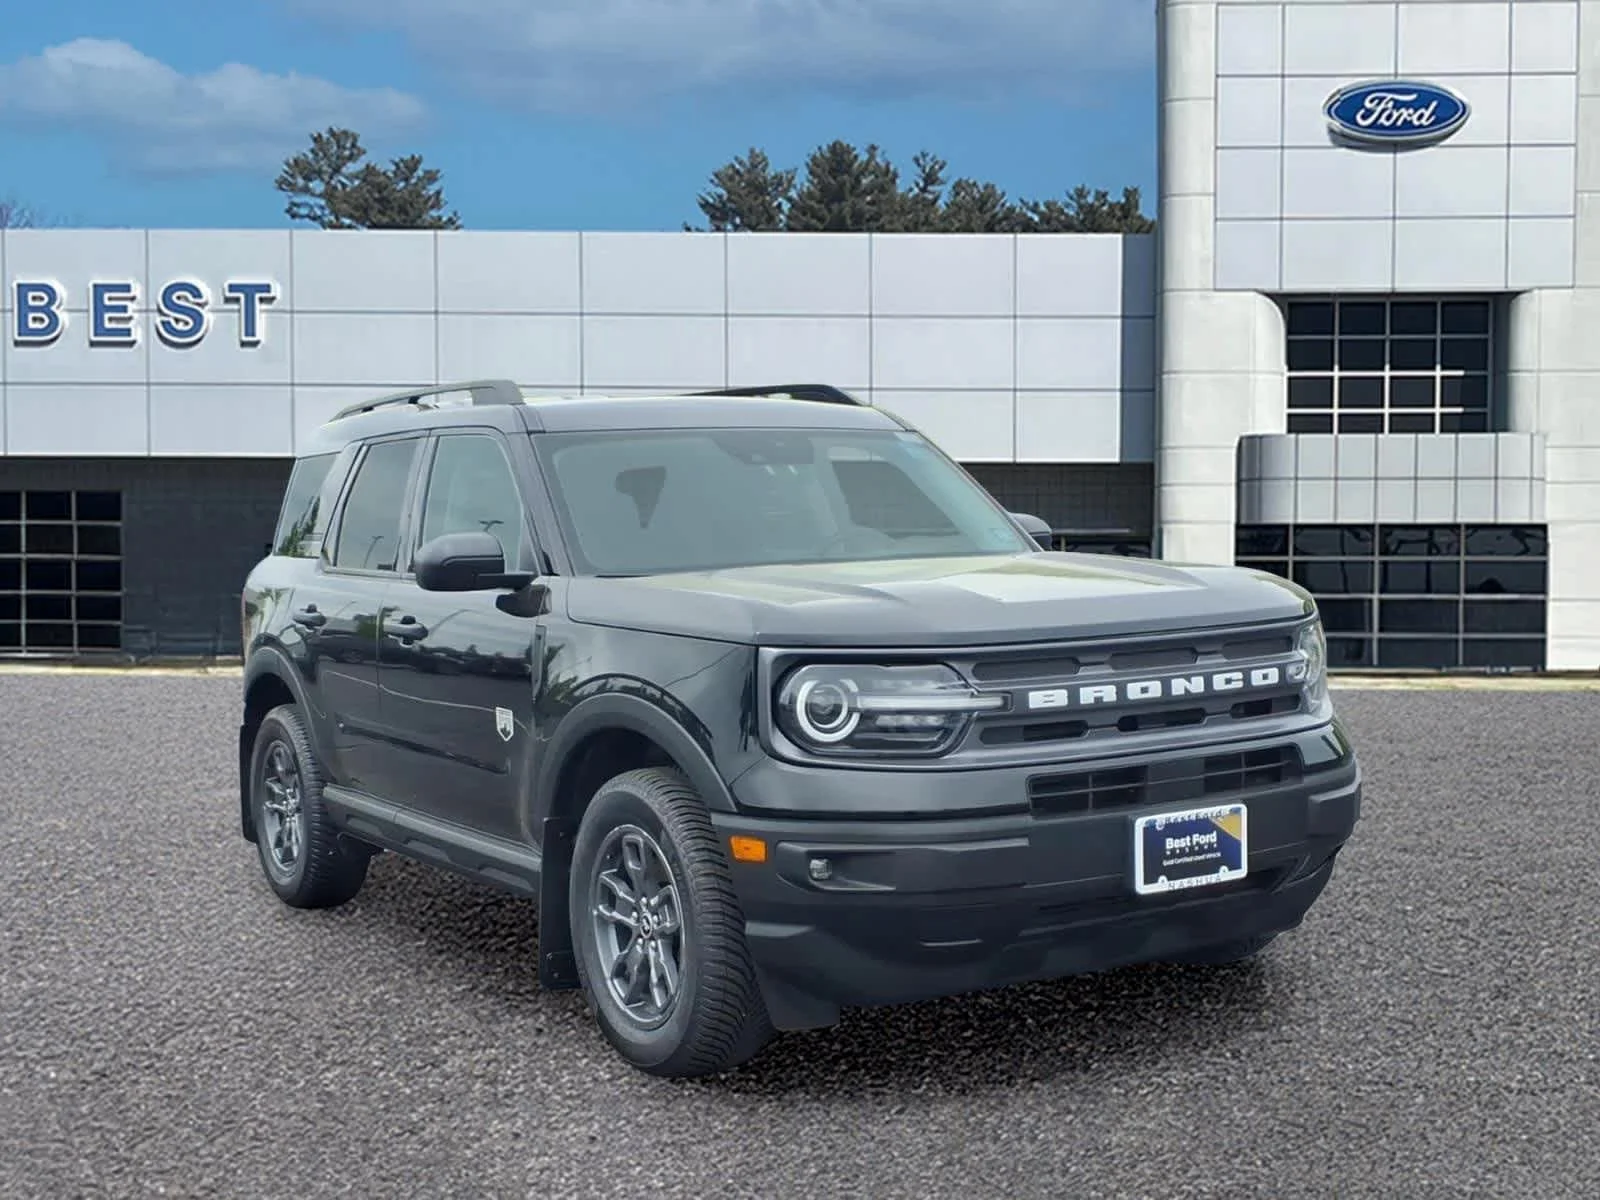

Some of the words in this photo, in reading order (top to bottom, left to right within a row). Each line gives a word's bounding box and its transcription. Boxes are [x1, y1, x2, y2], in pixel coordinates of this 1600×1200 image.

[1355, 92, 1438, 127] Ford
[13, 279, 277, 348] BEST
[1028, 667, 1279, 709] BRONCO
[1165, 836, 1190, 849] Best
[1191, 830, 1217, 845] Ford
